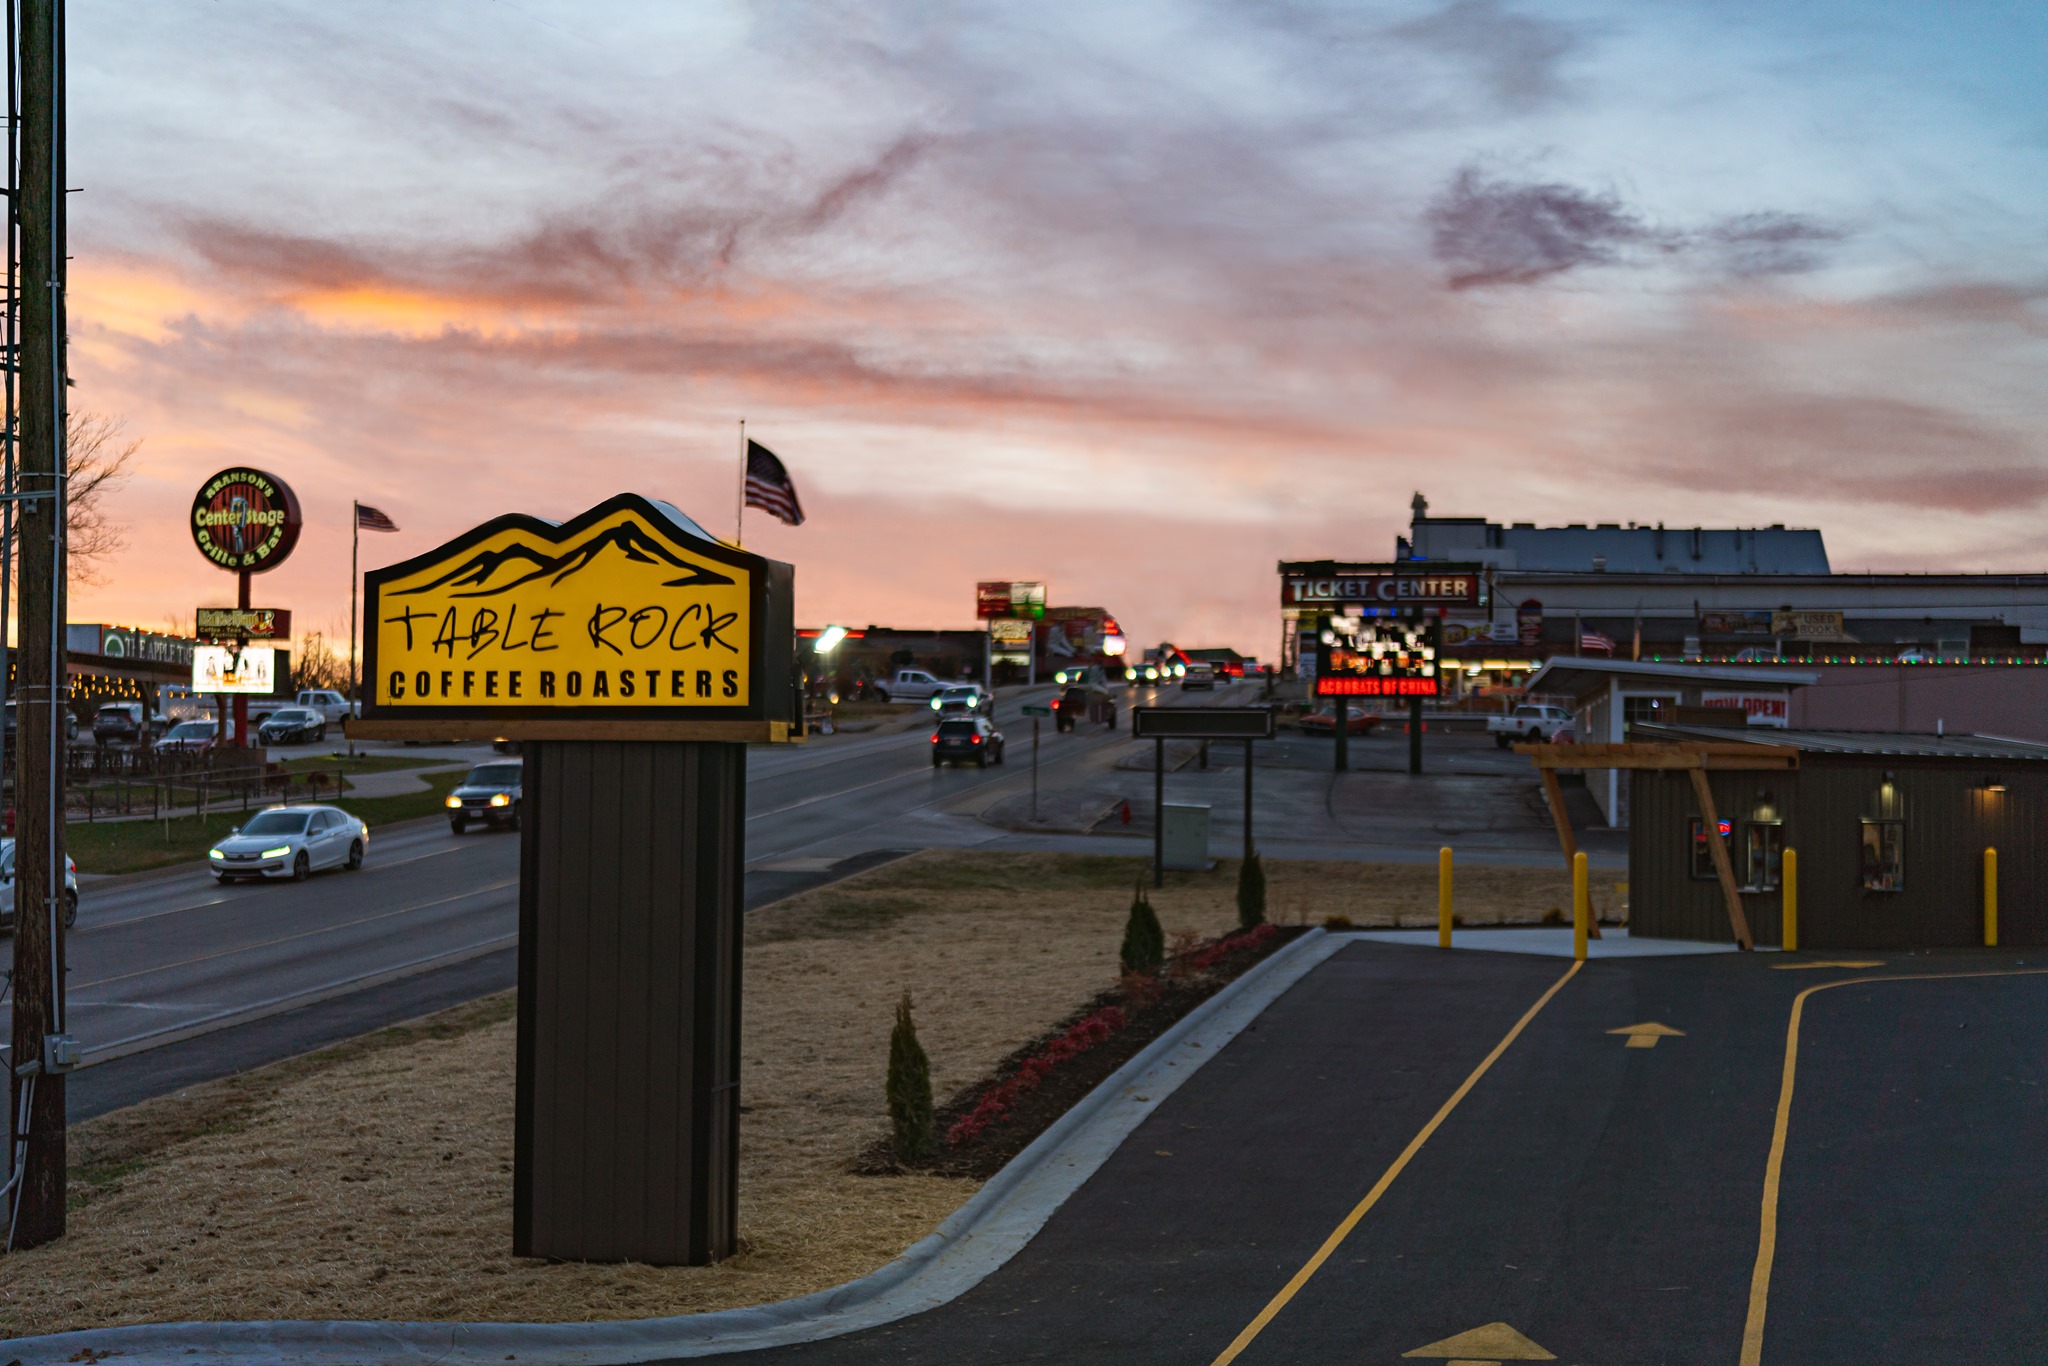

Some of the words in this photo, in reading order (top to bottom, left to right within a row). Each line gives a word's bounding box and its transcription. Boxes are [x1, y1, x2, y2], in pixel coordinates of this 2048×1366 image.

[205, 472, 274, 500] BRANSON'S
[195, 507, 241, 527] Center
[245, 508, 285, 527] Stage
[197, 530, 237, 566] Grille
[243, 553, 256, 566] &
[256, 526, 283, 560] Bar
[1290, 580, 1370, 602] TICKET
[1377, 580, 1468, 602] CENTER
[1799, 625, 1840, 634] BOOKS
[1803, 615, 1836, 624] USED
[384, 605, 566, 661] TABLE
[588, 603, 739, 657] ROCK
[147, 641, 176, 663] APPLE
[176, 645, 194, 665] TRE
[389, 670, 522, 699] COFFEE
[539, 669, 739, 698] ROASTERS
[1318, 677, 1381, 696] ACROBATS
[1381, 677, 1398, 696] OF
[1398, 677, 1438, 696] CHINA
[1742, 698, 1786, 718] OPEN!
